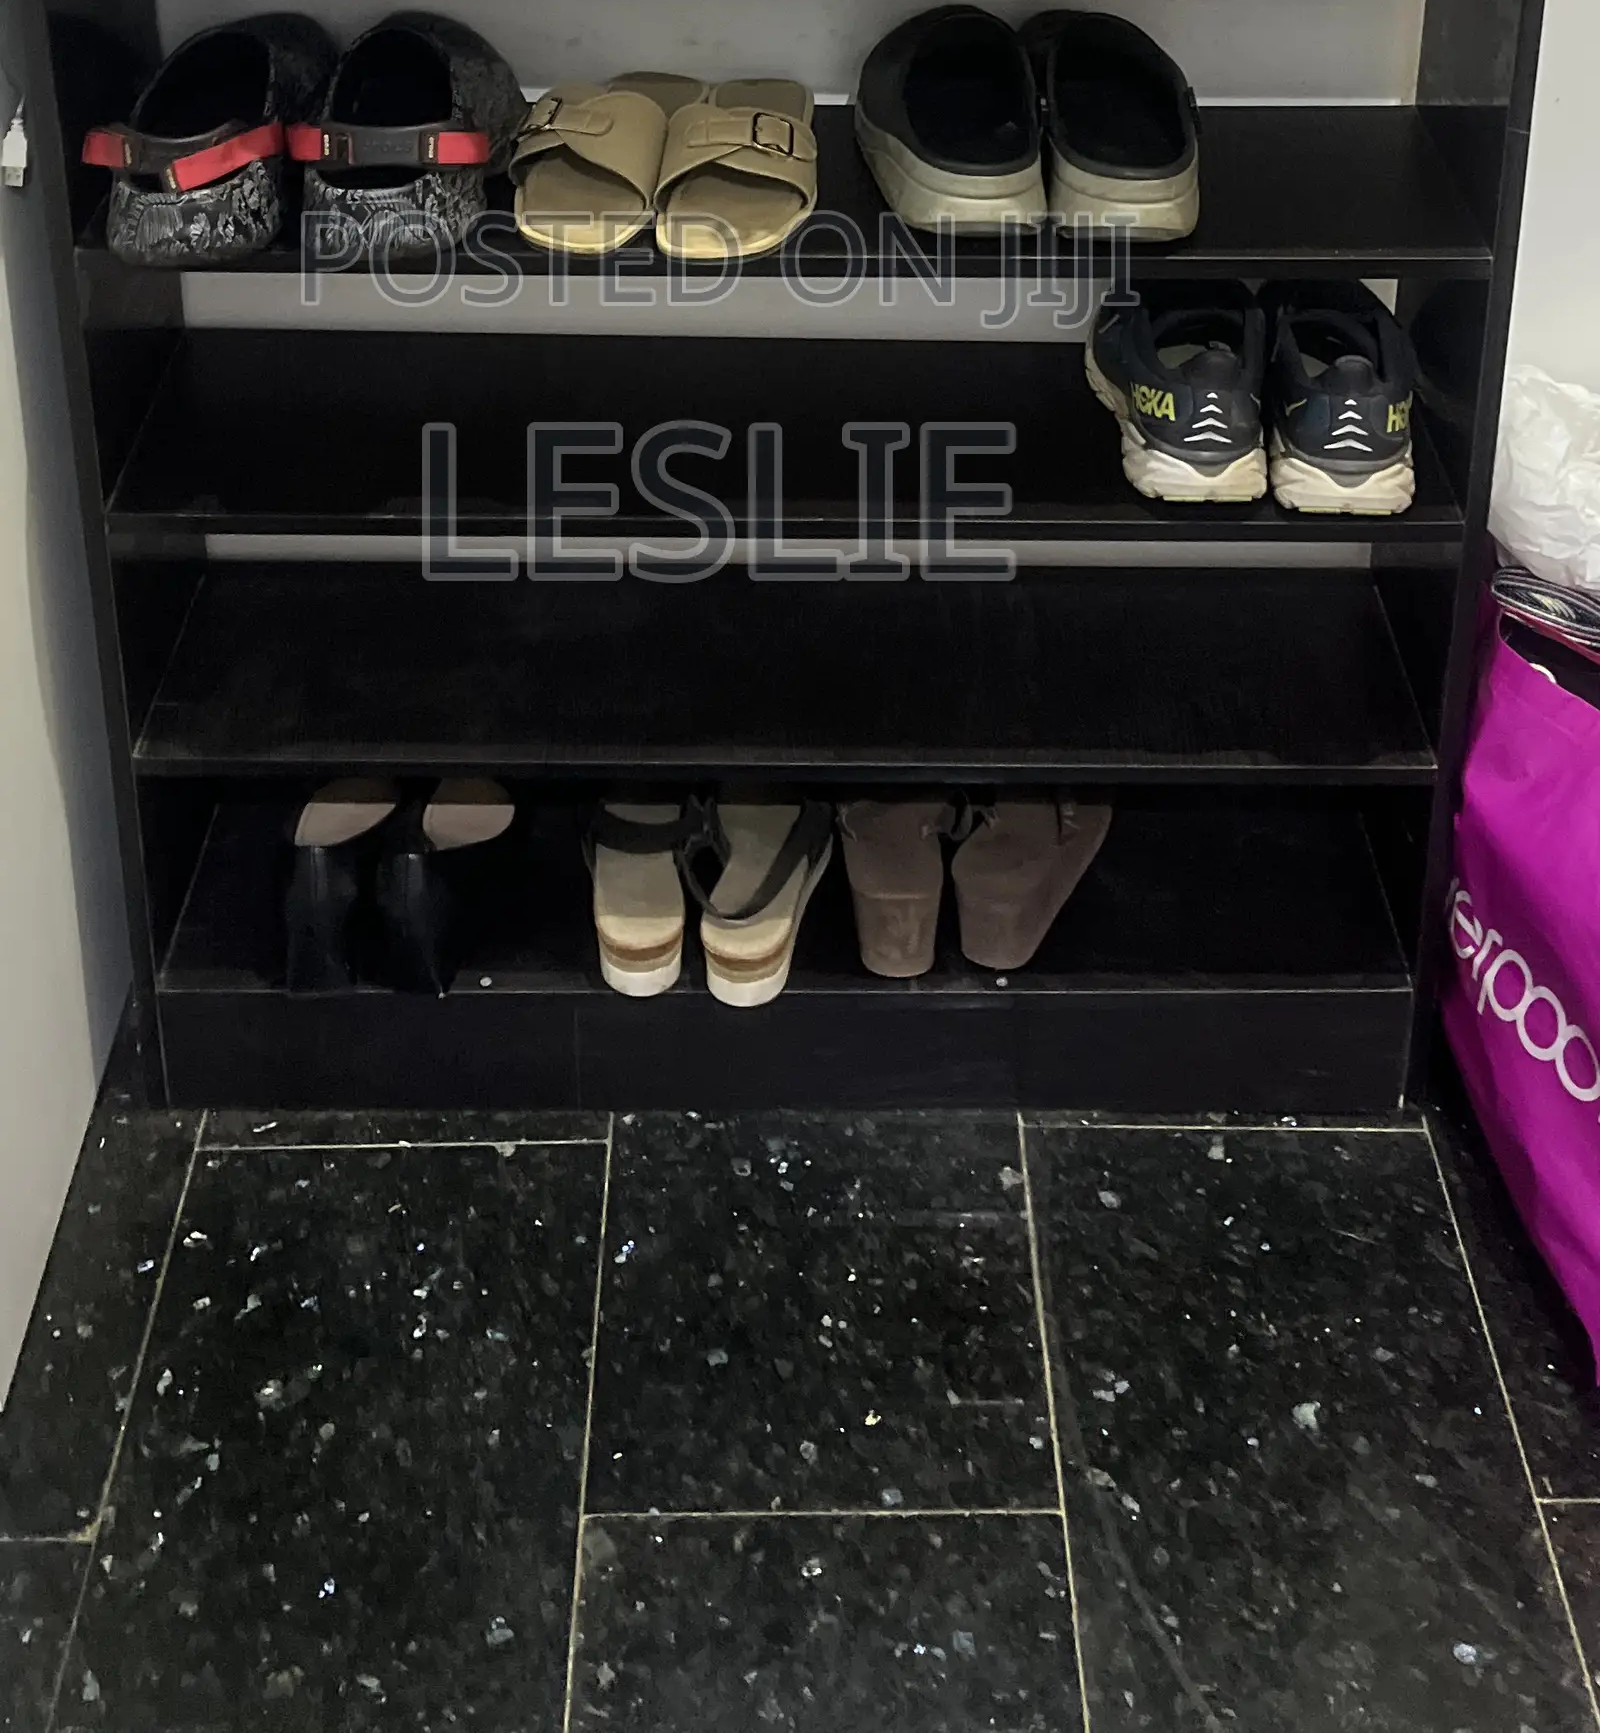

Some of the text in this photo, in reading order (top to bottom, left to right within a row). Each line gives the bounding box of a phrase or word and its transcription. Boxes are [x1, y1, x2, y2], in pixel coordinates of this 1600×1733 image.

[1130, 381, 1176, 422] HOKA
[1386, 390, 1413, 433] HO
[1444, 877, 1600, 1124] erpoo
